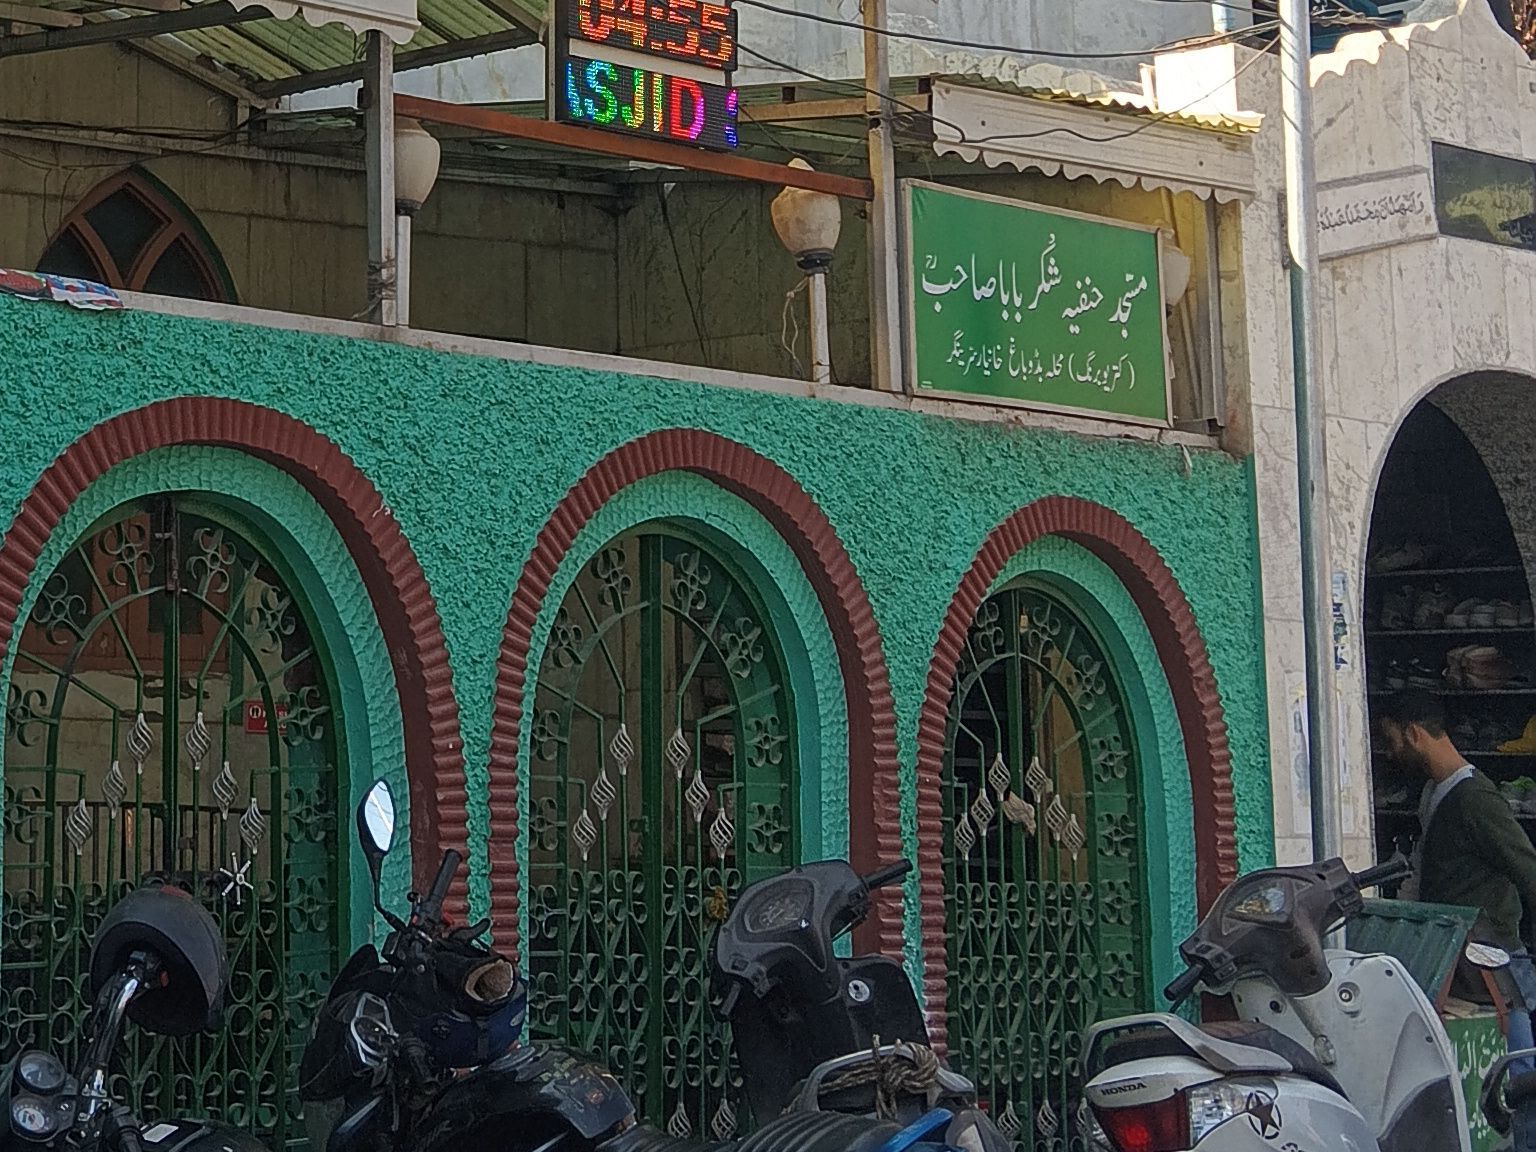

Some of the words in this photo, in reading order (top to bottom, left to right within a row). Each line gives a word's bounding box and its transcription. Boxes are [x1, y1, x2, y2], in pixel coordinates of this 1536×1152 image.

[999, 259, 1023, 323] بابا
[1108, 273, 1148, 339] مسجد
[1101, 1082, 1147, 1096] HONDA
